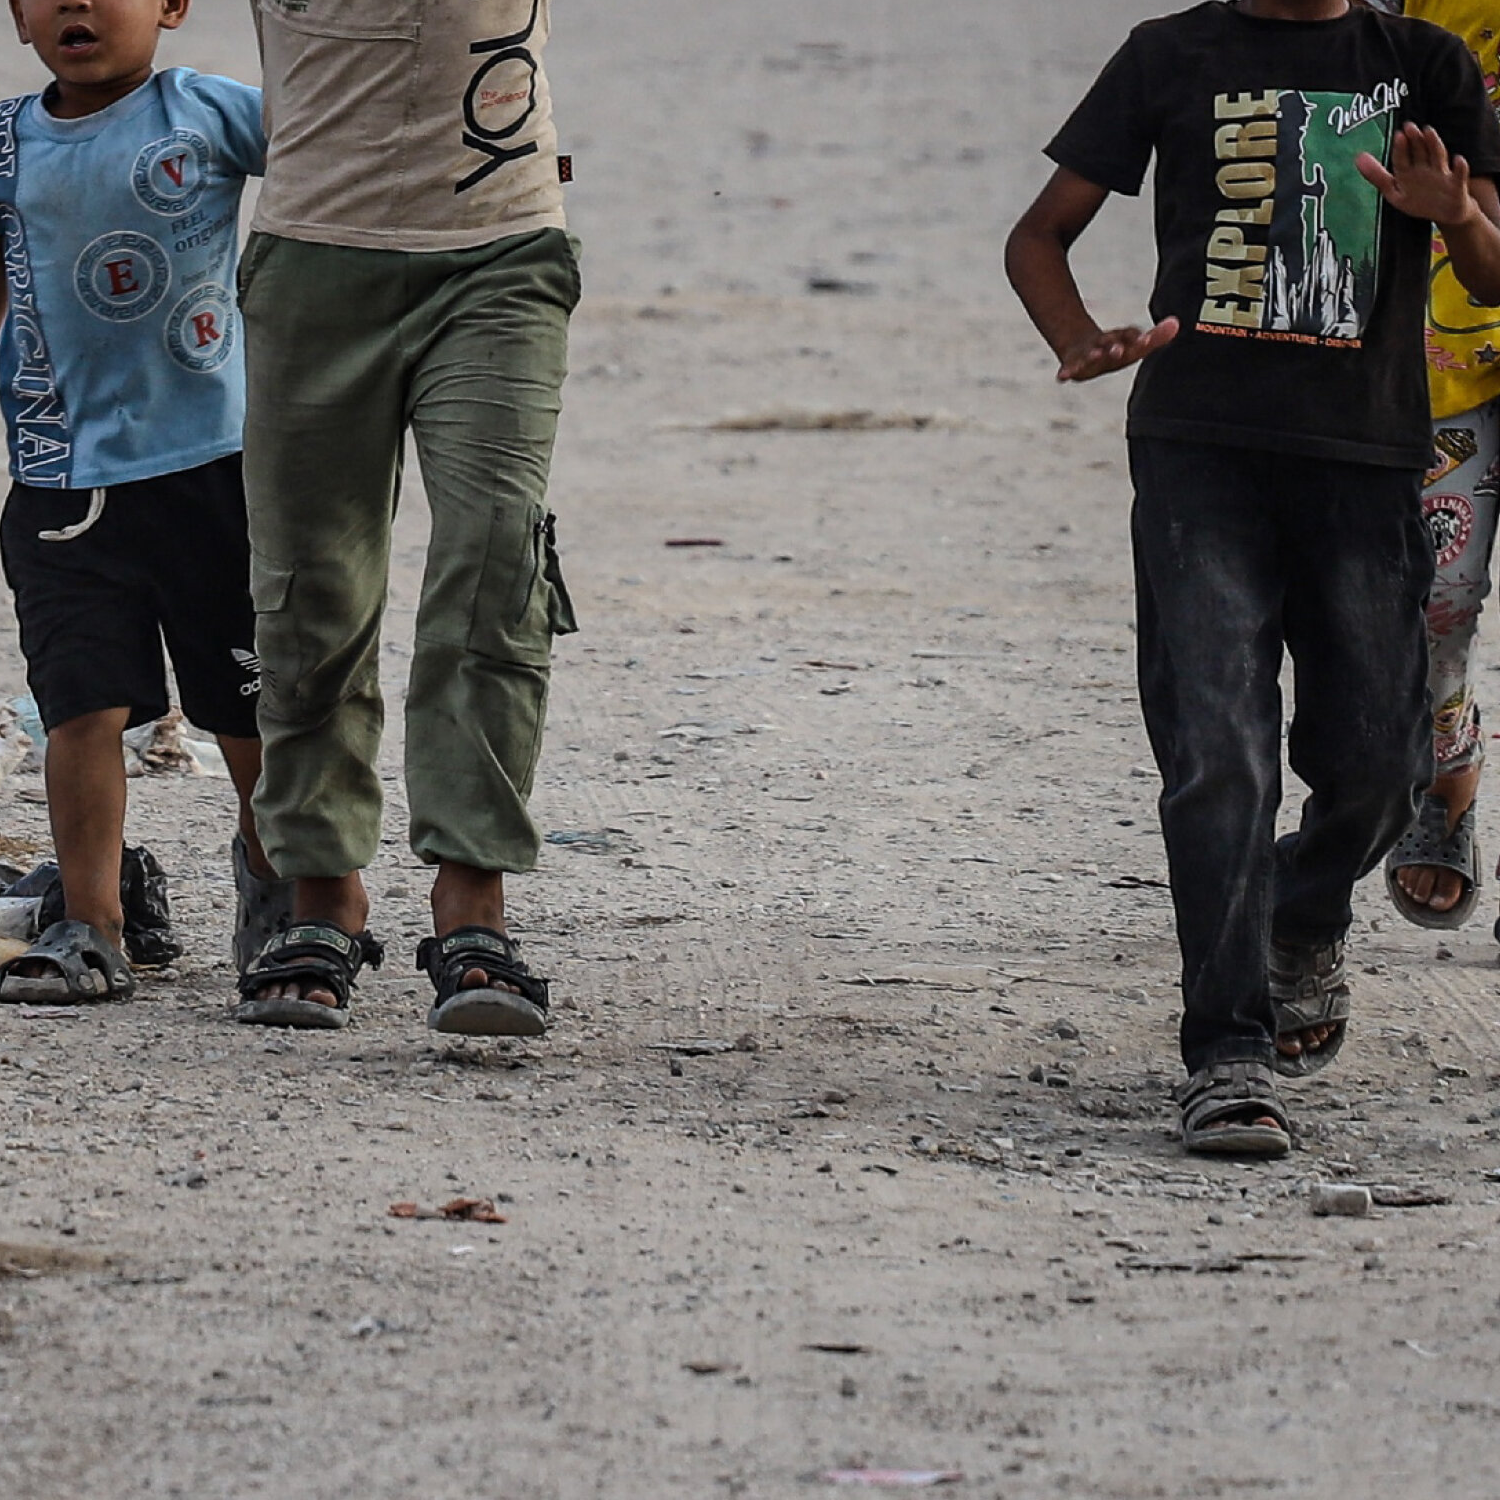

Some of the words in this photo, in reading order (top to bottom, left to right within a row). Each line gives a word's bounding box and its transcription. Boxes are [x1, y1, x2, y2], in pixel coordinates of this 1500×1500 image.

[1373, 77, 1410, 113] Life
[160, 153, 188, 189] V
[171, 209, 207, 235] FEEL
[1199, 89, 1278, 329] EXPLORE
[104, 259, 139, 296] E
[191, 311, 220, 349] R
[1255, 331, 1317, 345] ADVENTURE
